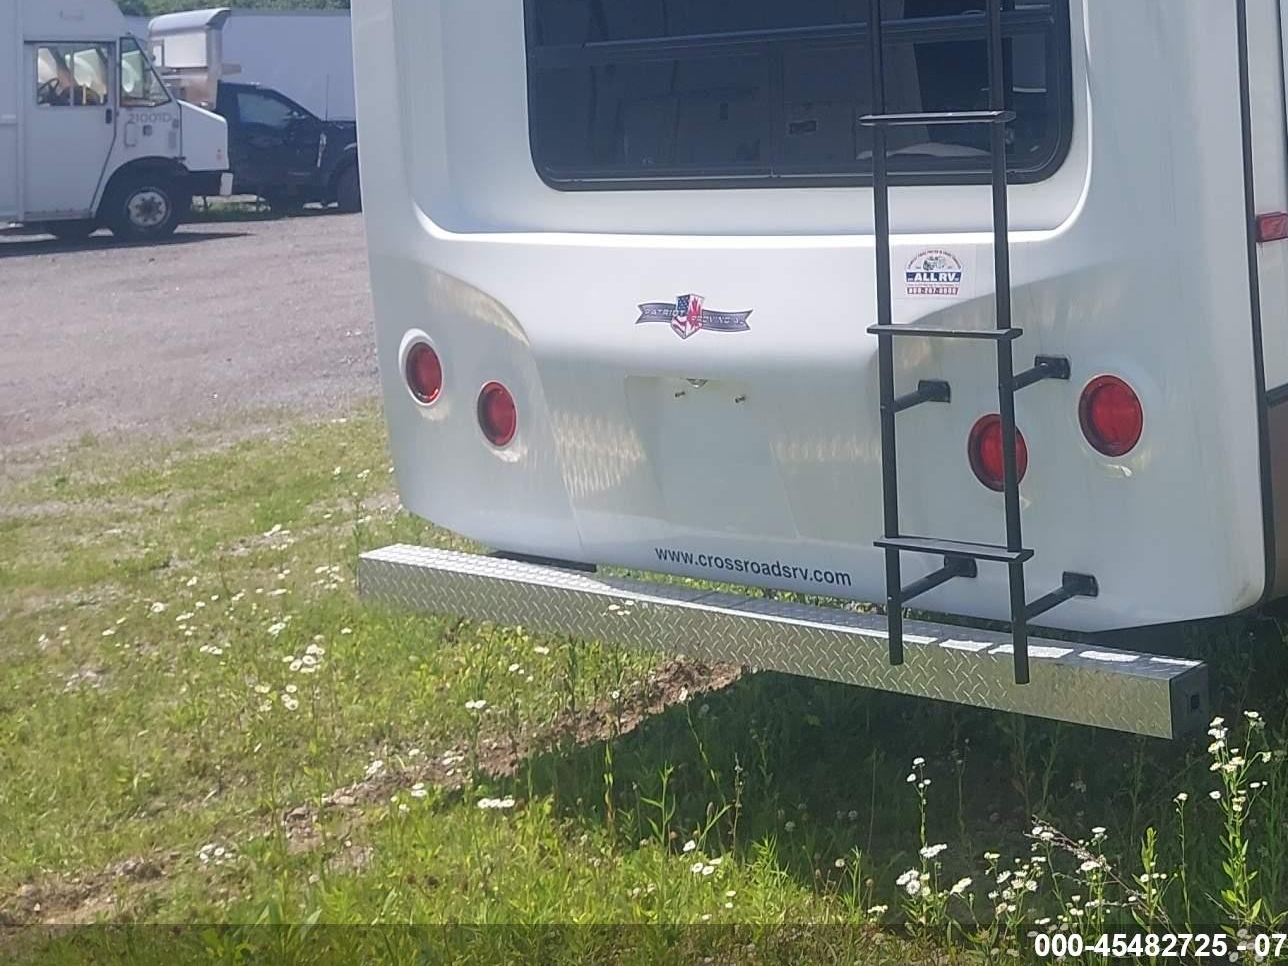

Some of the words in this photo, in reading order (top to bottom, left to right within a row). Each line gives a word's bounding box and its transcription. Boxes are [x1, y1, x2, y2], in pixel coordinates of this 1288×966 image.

[914, 273, 937, 282] ALL
[938, 273, 956, 282] RV
[643, 307, 685, 318] PATRIOT
[654, 547, 852, 587] www.crossroadsrv.com
